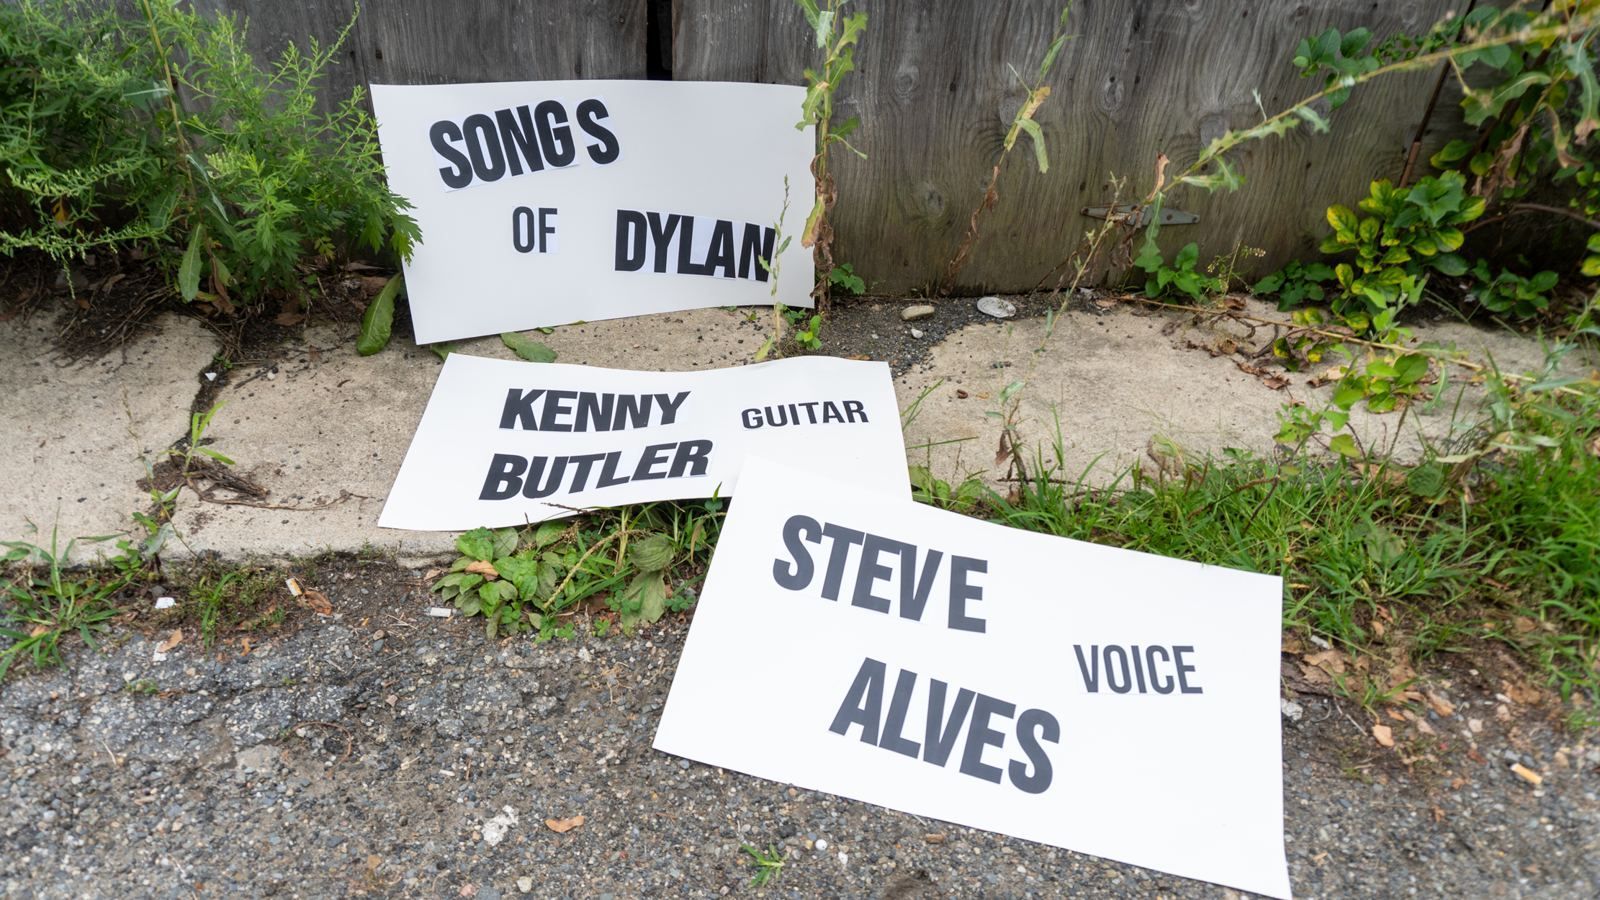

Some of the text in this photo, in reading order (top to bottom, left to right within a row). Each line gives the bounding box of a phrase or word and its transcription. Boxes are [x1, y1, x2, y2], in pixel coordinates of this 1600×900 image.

[429, 98, 620, 189] SONGS
[512, 206, 776, 283] OF DYLAN
[499, 388, 691, 433] KENNY
[741, 400, 869, 429] GUITAR
[478, 439, 713, 501] BUTLER
[773, 514, 988, 633] STEVE
[1073, 644, 1203, 694] VOICE
[829, 657, 1060, 794] ALVES
